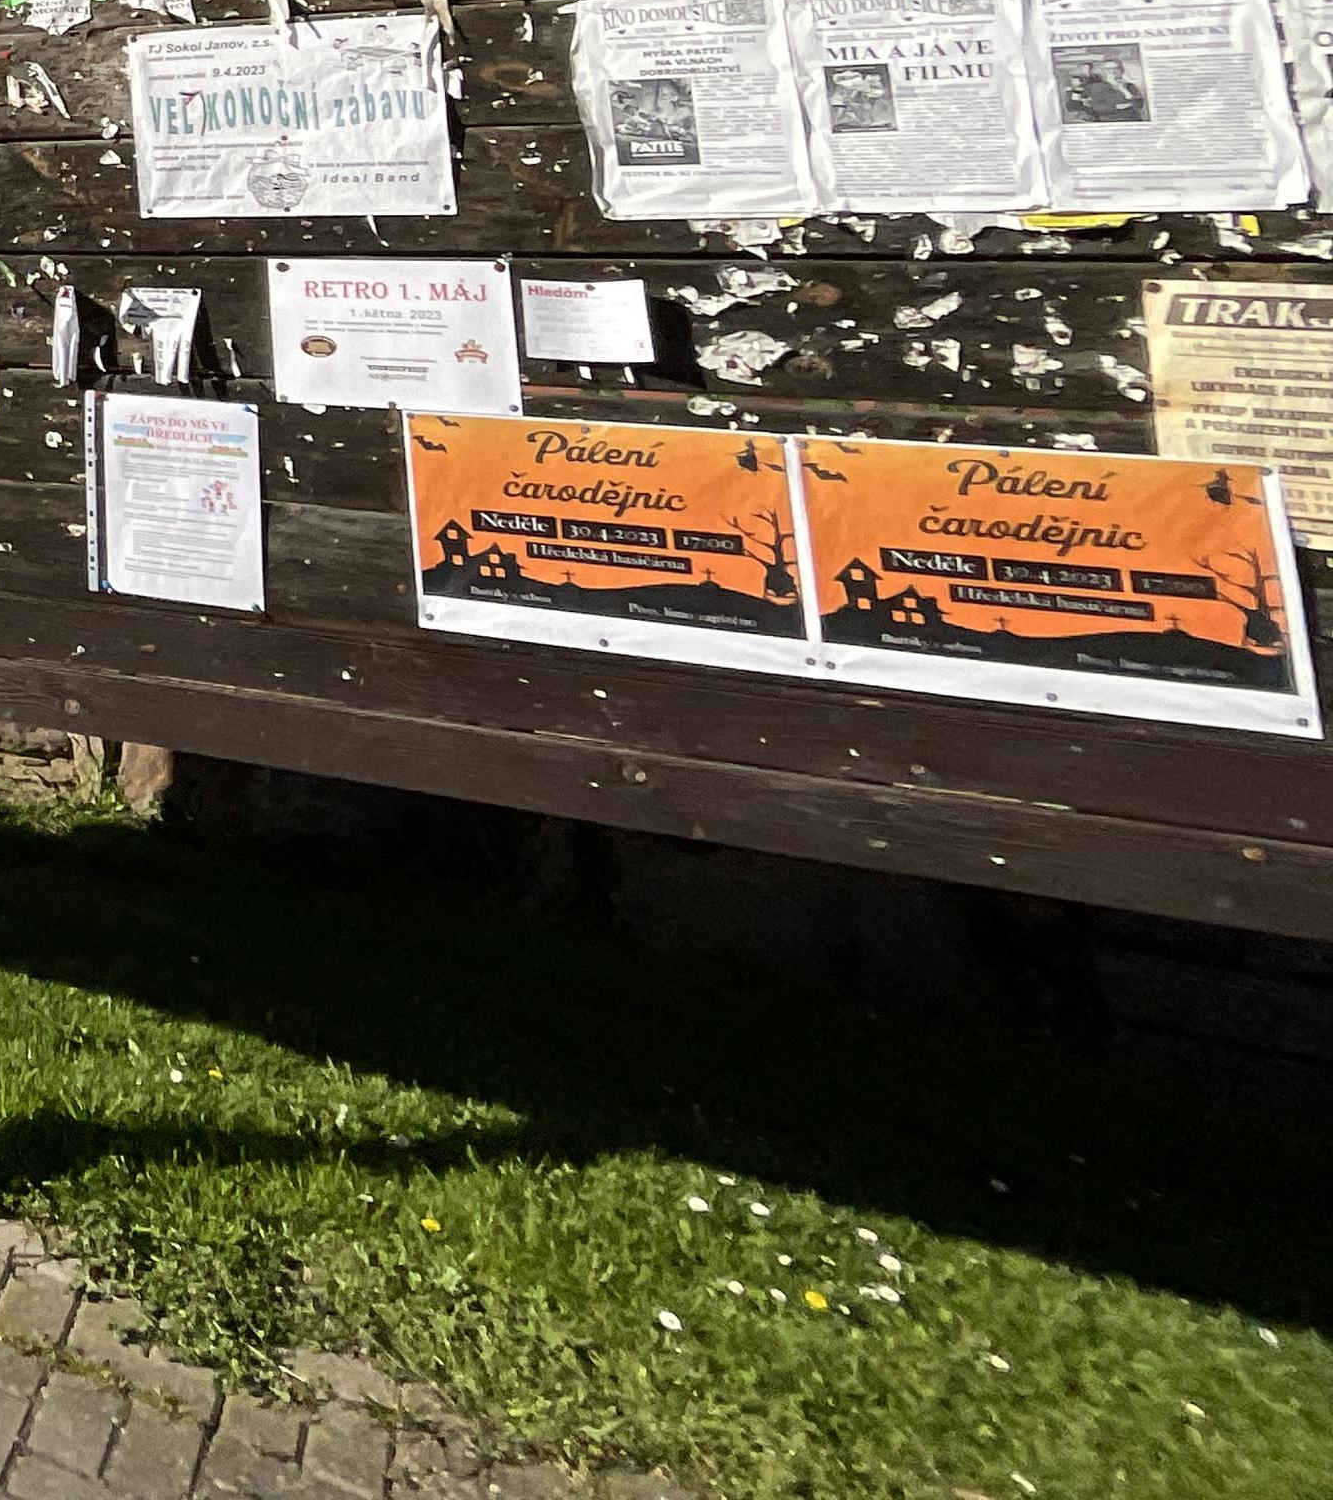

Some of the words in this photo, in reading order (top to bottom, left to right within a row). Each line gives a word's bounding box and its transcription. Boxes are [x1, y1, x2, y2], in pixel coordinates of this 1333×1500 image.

[147, 45, 162, 54] TJ
[166, 42, 202, 54] Sokol
[205, 40, 249, 51] Janov,
[826, 46, 879, 61] MIA
[888, 45, 905, 59] A
[955, 40, 995, 55] VE
[212, 65, 266, 78] 9.4.2023
[904, 63, 994, 81] FILMU
[333, 83, 425, 127] zábavu
[630, 141, 685, 155] PATTIE
[323, 173, 368, 183] Ideal
[374, 173, 420, 183] Band
[304, 280, 389, 300] RETRO
[398, 283, 421, 300] 1.
[429, 278, 488, 302] MÁJ
[410, 309, 443, 321] 2023
[1179, 299, 1307, 328] TRAK
[168, 416, 186, 428] DO
[526, 430, 666, 468] Pálení
[947, 458, 1117, 501] Pálení
[503, 471, 687, 518] čarodějnic
[479, 511, 550, 534] Neděle
[569, 524, 659, 546] 30.4.2023
[918, 504, 1149, 557] čarodějnic
[890, 550, 977, 574] Neděle
